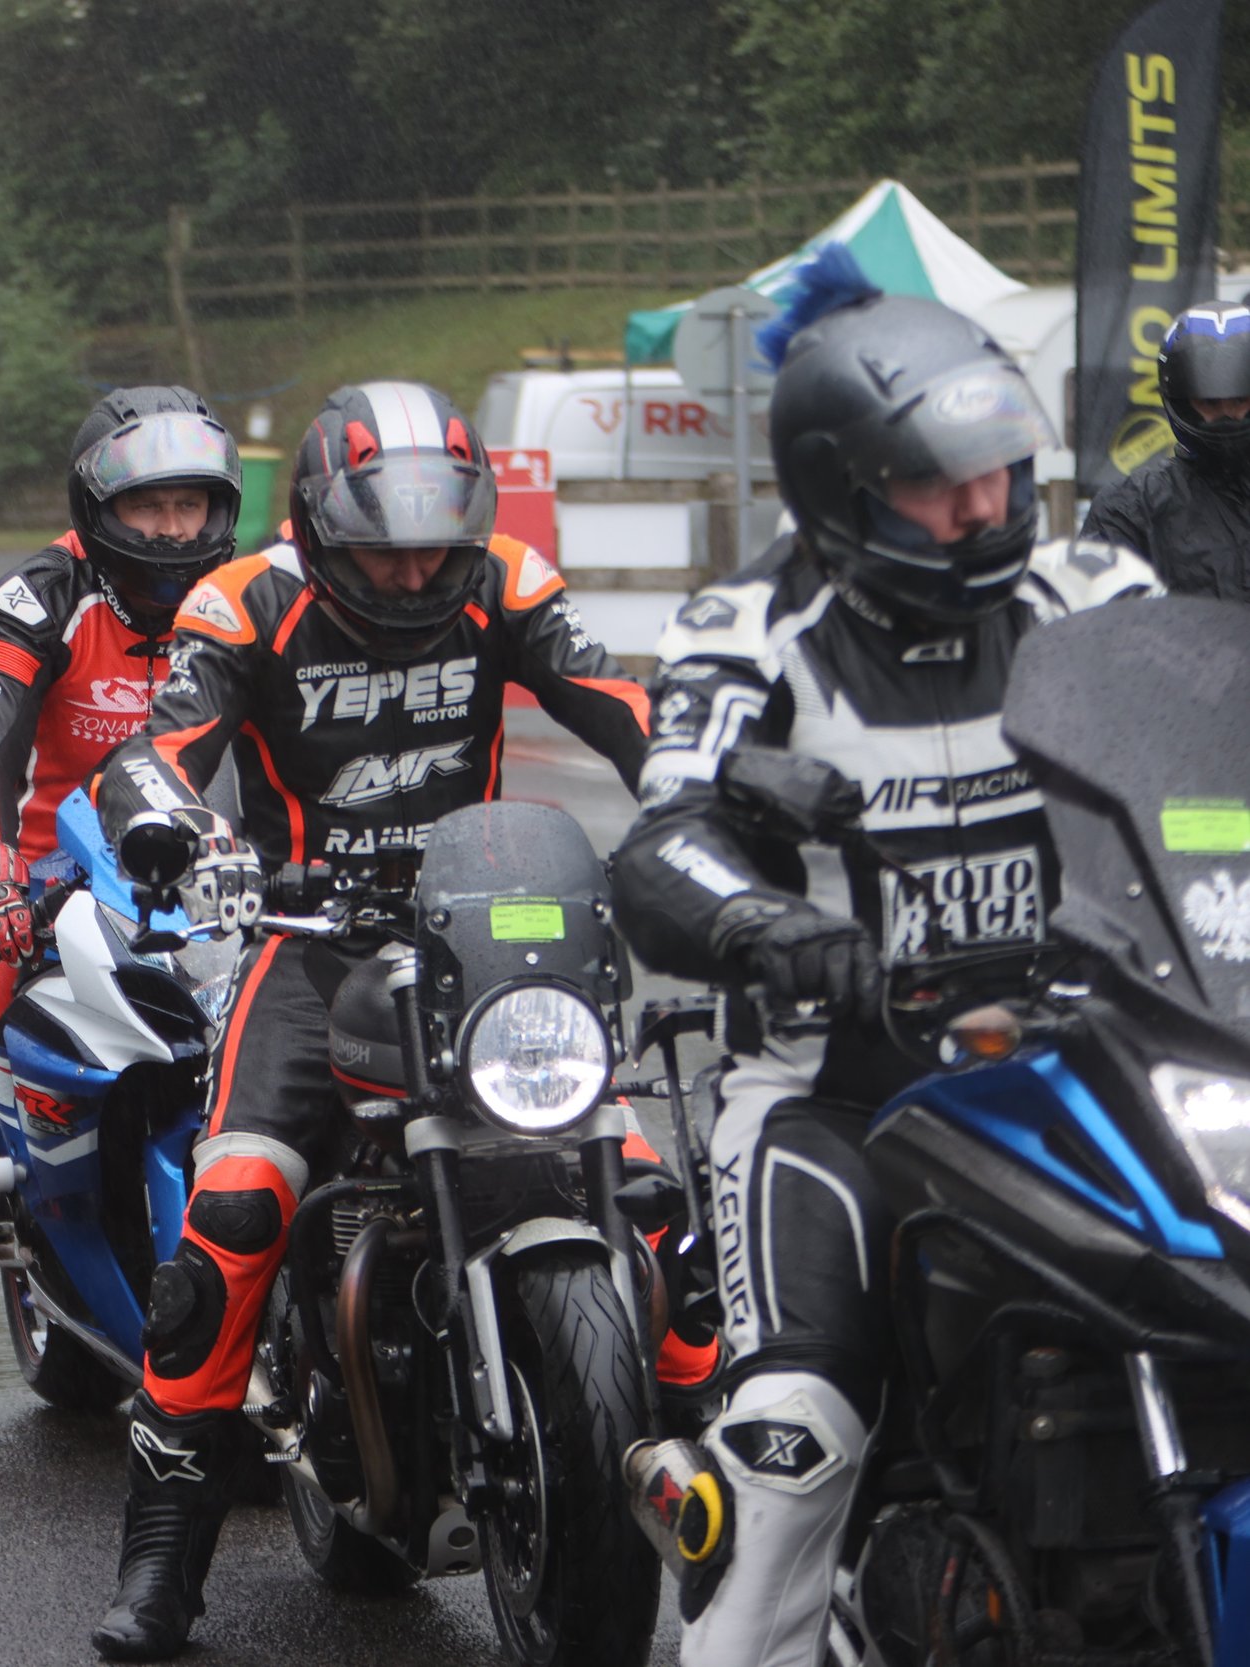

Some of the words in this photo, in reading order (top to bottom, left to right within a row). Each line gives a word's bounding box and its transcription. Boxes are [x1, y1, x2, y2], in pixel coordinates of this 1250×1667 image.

[1125, 52, 1178, 282] LIMITS
[296, 661, 368, 681] CIRCUITO
[297, 656, 477, 733] YEPES
[413, 704, 468, 724] MOTOR
